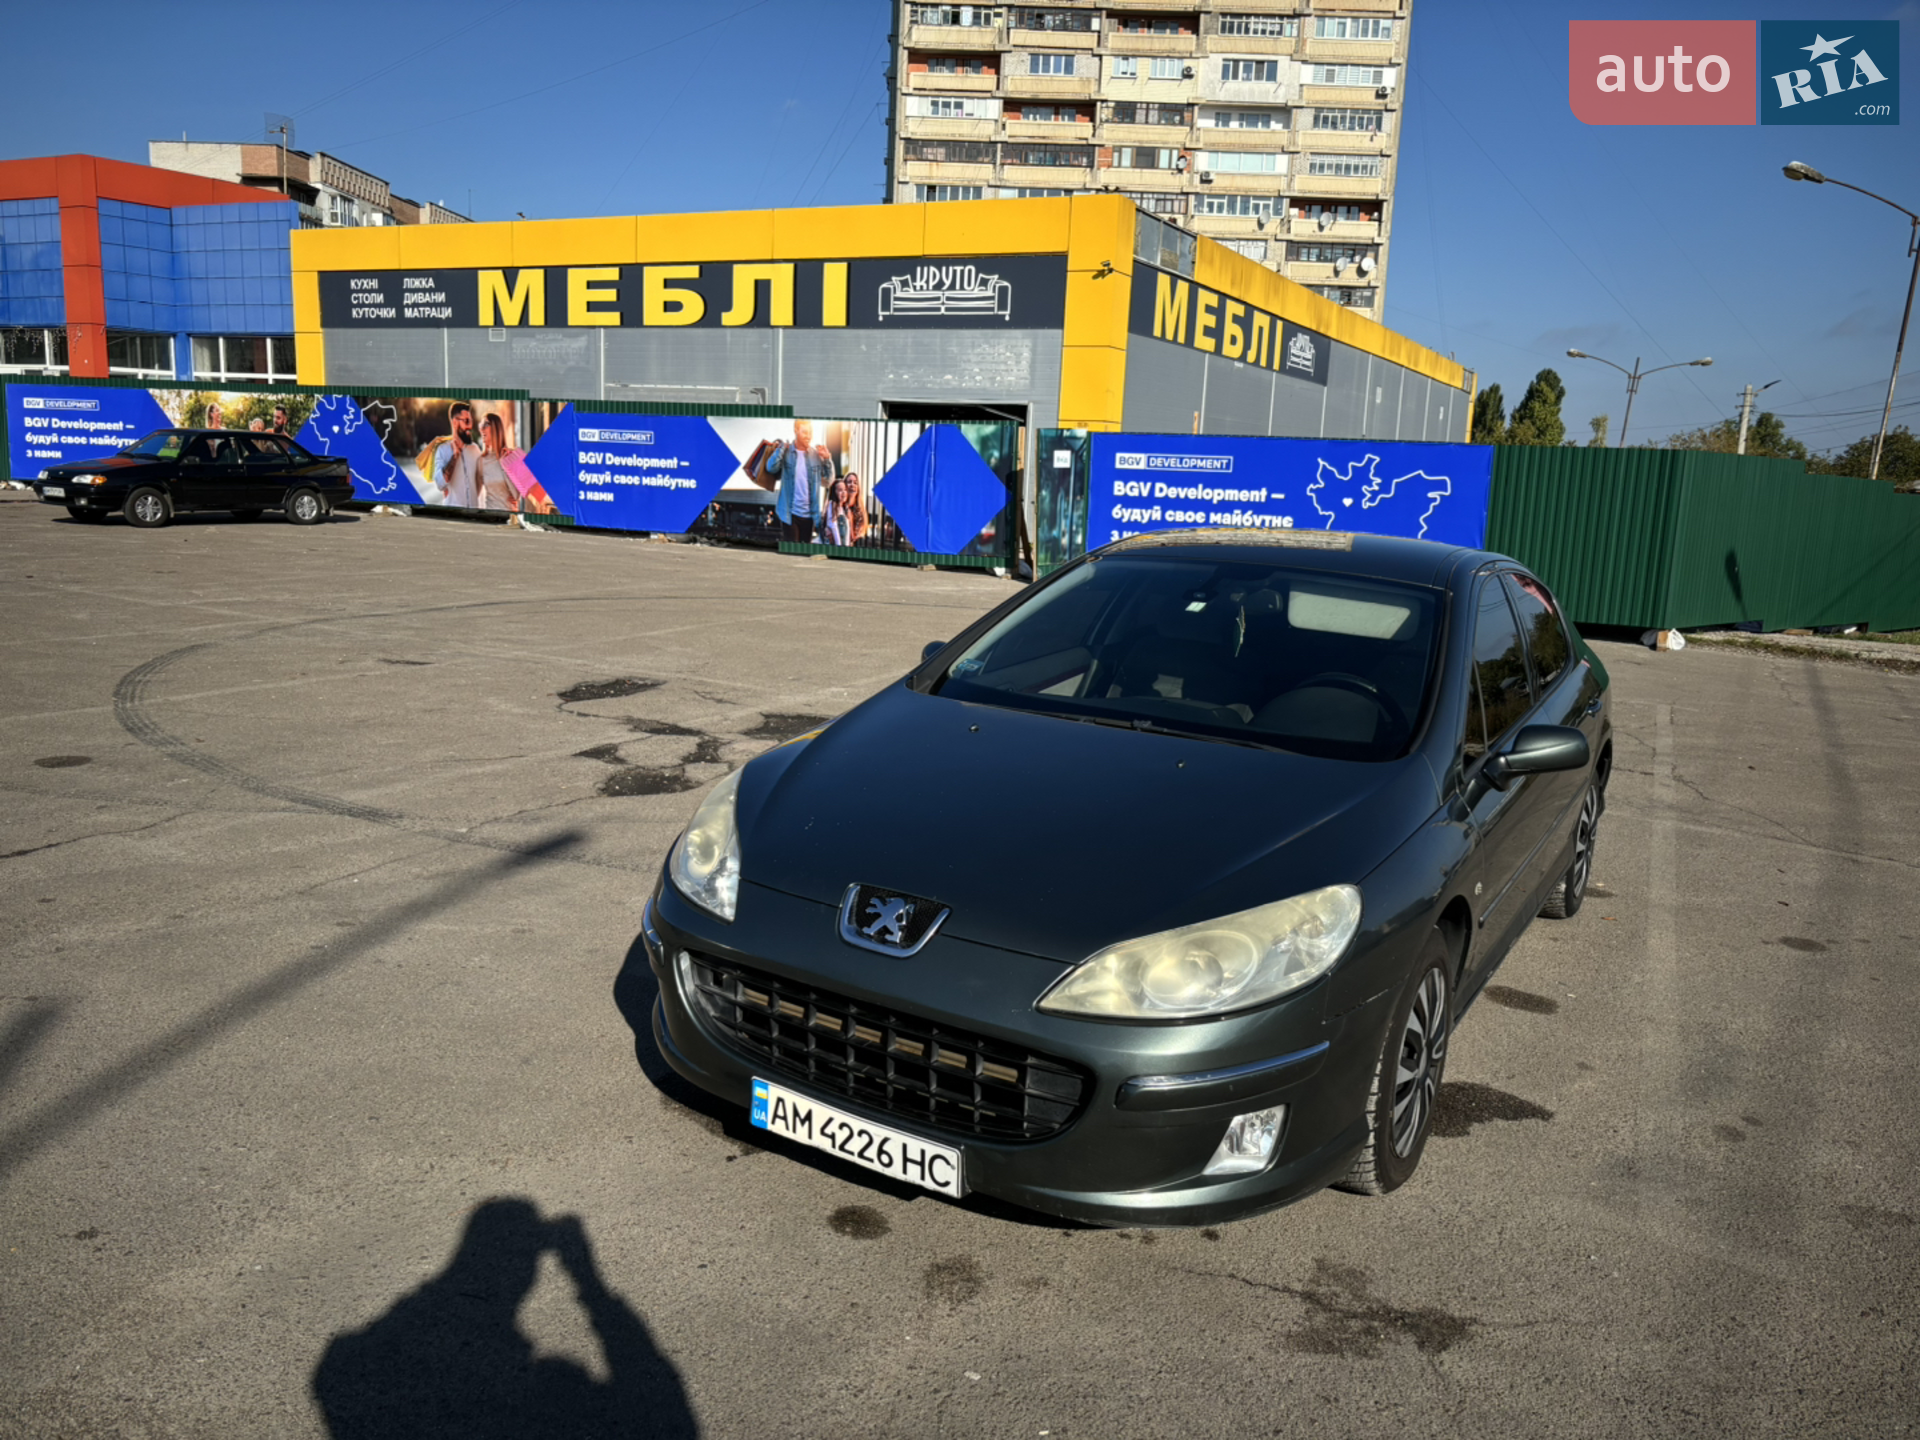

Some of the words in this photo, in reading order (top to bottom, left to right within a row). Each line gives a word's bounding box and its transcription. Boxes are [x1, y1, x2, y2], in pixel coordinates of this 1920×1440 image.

[350, 278, 379, 290] КУХНІ
[403, 277, 435, 289] ЛІЖКА
[913, 265, 976, 291] КРУТО
[351, 292, 385, 305] СТОЛИ
[403, 292, 446, 306] ДИВАНИ
[477, 262, 848, 326] МЕБЛІ
[352, 307, 397, 319] КУТОЧКИ
[404, 307, 453, 320] МАТРАЦИ
[1153, 271, 1284, 371] МЕБЛІ
[45, 400, 97, 409] DEVELOPMENT
[24, 417, 49, 428] BGV
[51, 418, 124, 432] Development
[25, 432, 59, 446] будуй
[60, 435, 87, 445] своє
[580, 431, 597, 439] BGV
[600, 431, 652, 442] DEVELOPMENT
[26, 449, 33, 458] з
[34, 450, 62, 459] нами
[579, 451, 604, 465] BGV
[605, 453, 678, 469] Development
[1118, 456, 1143, 466] BGV
[1149, 457, 1229, 469] DEVELOPMENT
[579, 470, 611, 485] будуй
[613, 474, 640, 485] своє
[642, 473, 697, 490] майбутнє
[579, 490, 585, 500] з
[587, 491, 614, 502] нами
[1113, 480, 1152, 497] BGV
[1154, 483, 1268, 504] Development
[1111, 504, 1162, 524] будуй
[1165, 509, 1206, 523] своє
[1209, 509, 1294, 528] майбутнє
[754, 1108, 768, 1122] UA
[770, 1096, 813, 1141] AM
[819, 1116, 894, 1169] 4226
[902, 1142, 956, 1188] HC
